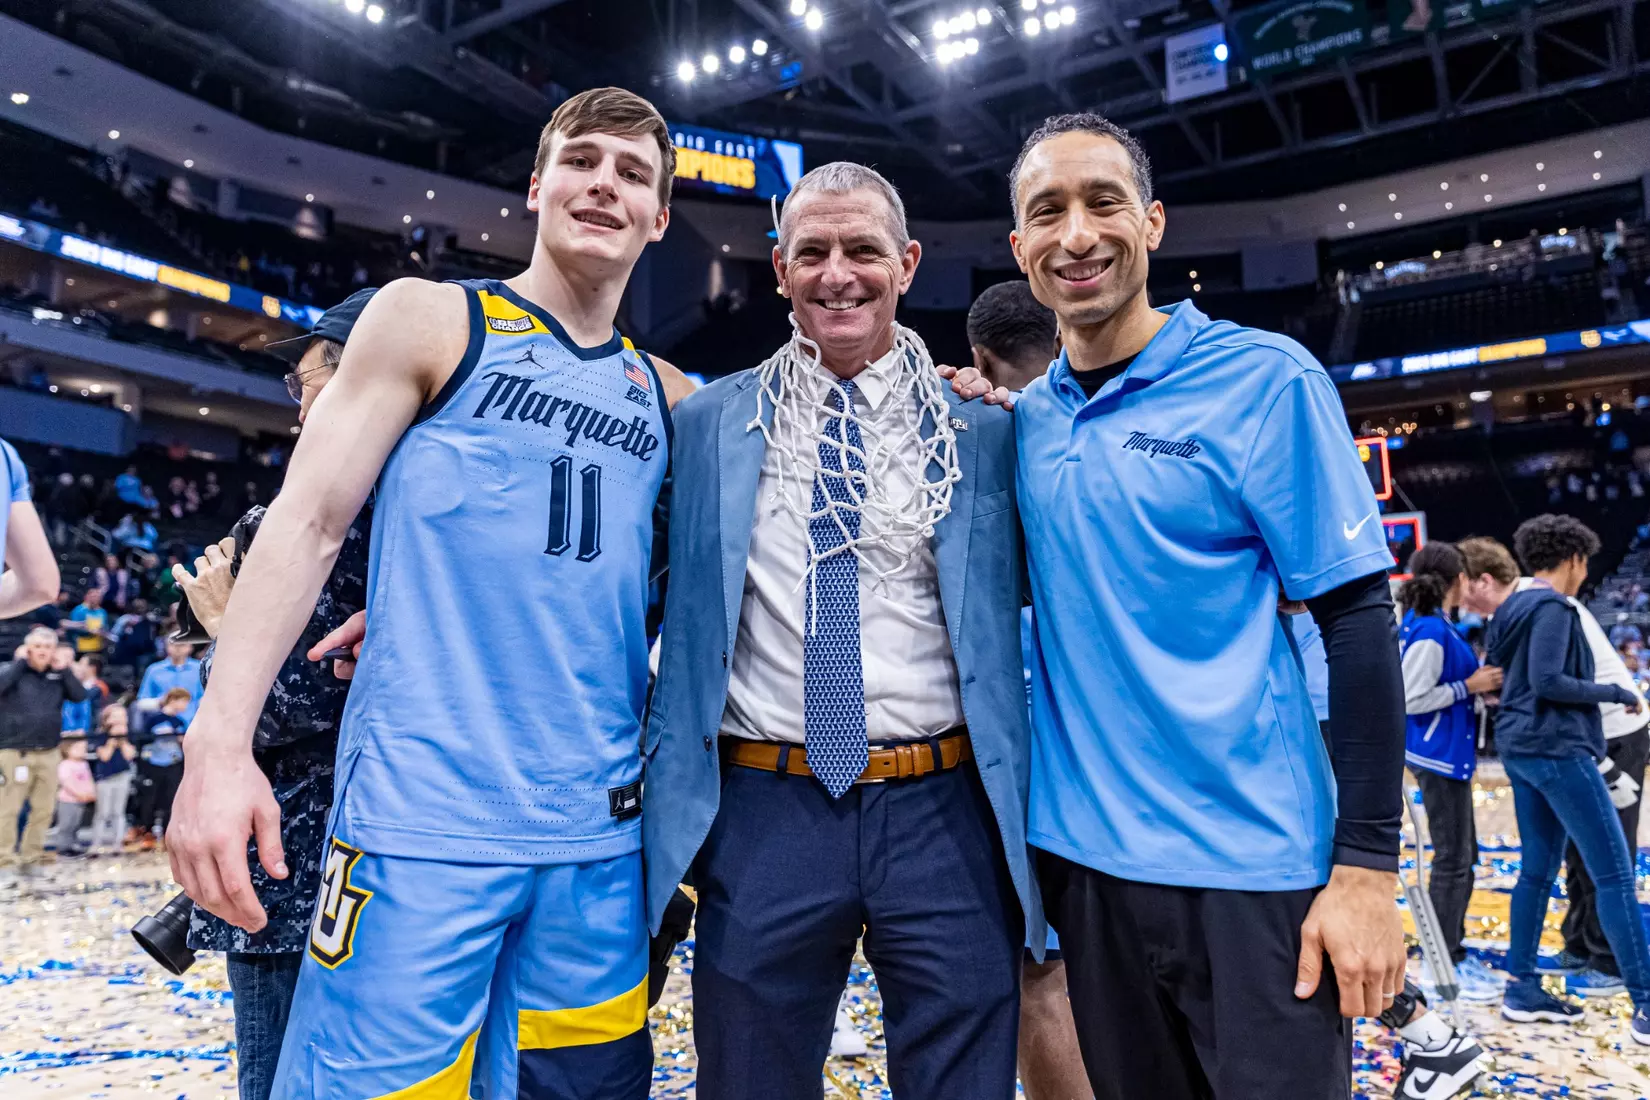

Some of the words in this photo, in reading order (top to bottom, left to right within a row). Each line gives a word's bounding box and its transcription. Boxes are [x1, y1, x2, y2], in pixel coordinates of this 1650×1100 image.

[1252, 48, 1292, 70] WORLD
[1294, 28, 1363, 57] CHAMPIONS
[675, 132, 705, 151] BIG
[715, 139, 755, 160] EAST
[626, 391, 652, 408] EAST
[629, 385, 648, 399] BIG
[472, 372, 659, 462] Marquette
[1122, 430, 1201, 459] Marquette
[543, 454, 601, 562] 11
